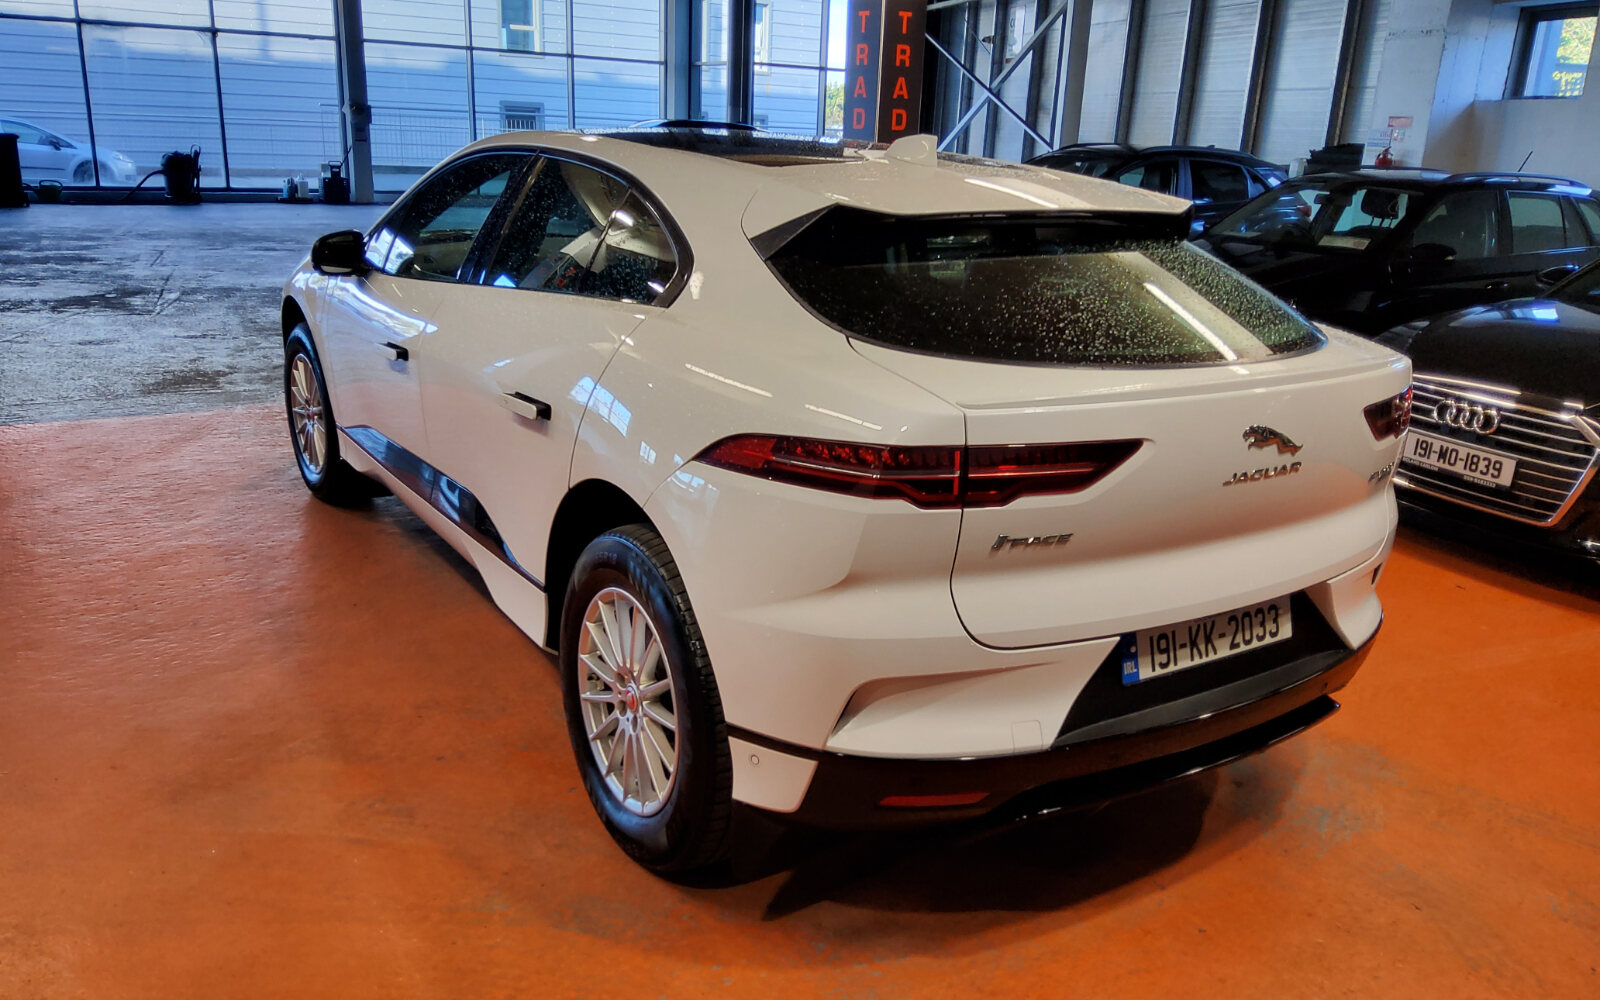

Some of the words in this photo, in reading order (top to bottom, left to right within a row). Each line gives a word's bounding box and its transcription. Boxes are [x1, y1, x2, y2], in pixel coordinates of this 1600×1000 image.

[853, 10, 870, 130] TRAD
[891, 10, 913, 132] TRAD
[1222, 461, 1302, 487] JAGUAR
[1413, 438, 1503, 479] 191-MO-1839
[1149, 603, 1281, 673] 191-KK-2033
